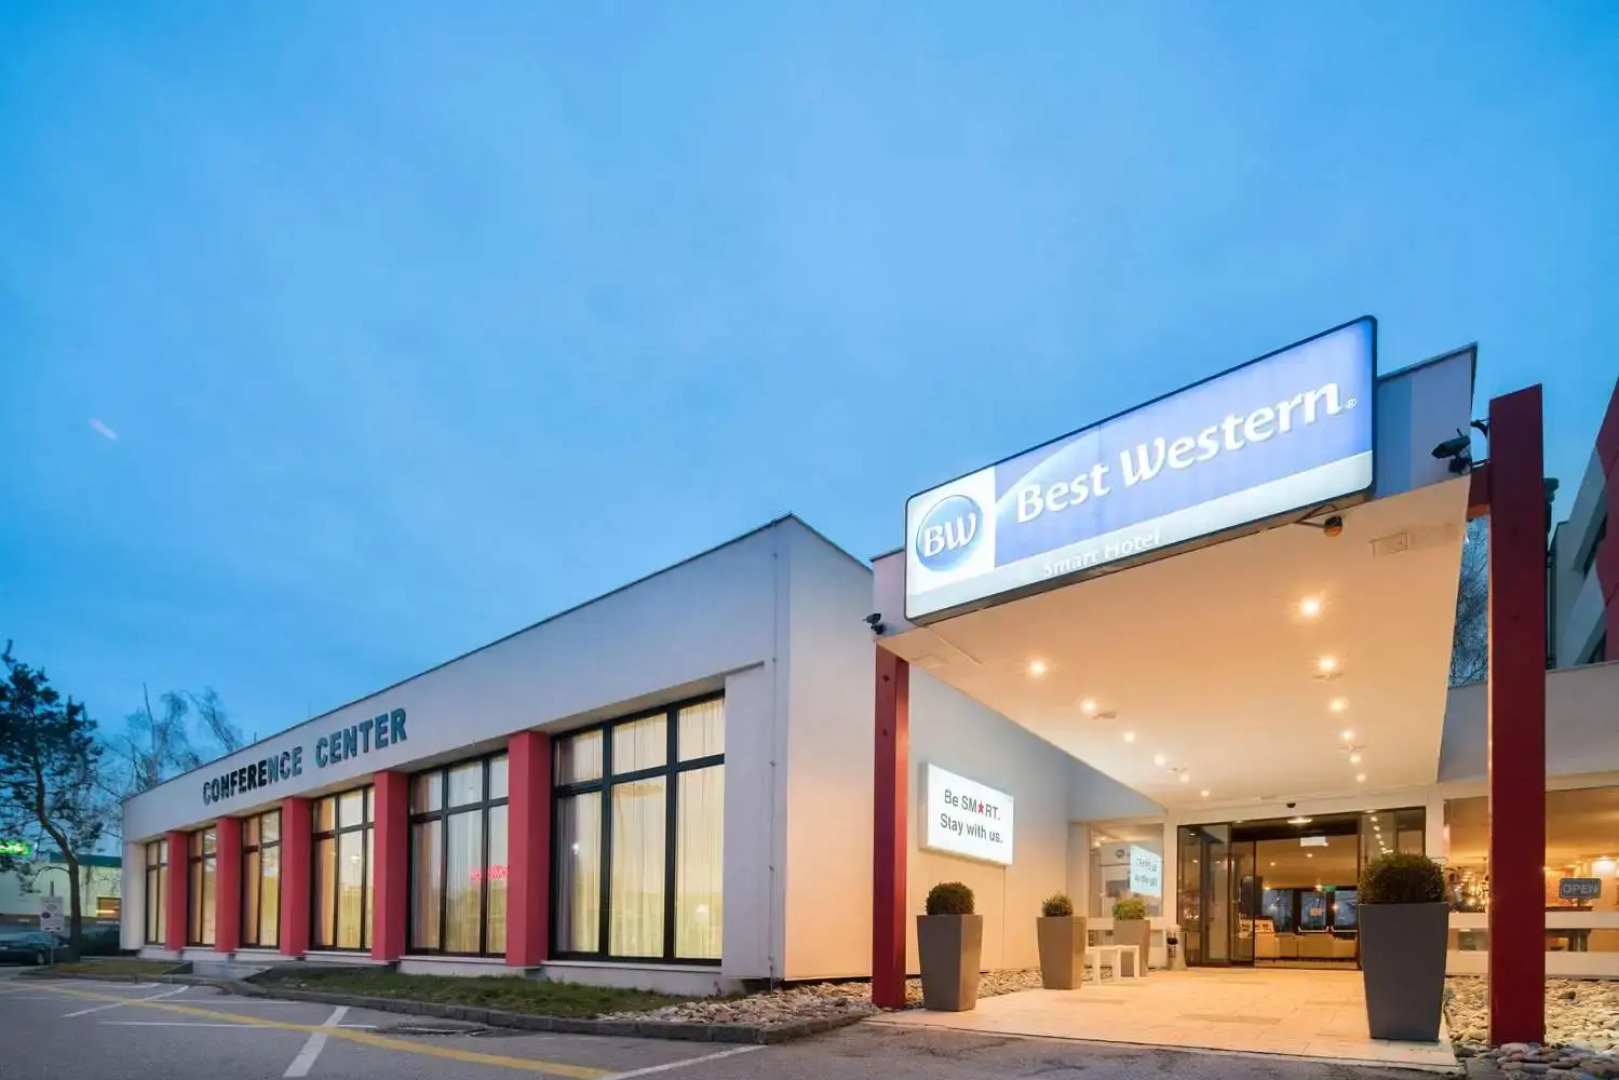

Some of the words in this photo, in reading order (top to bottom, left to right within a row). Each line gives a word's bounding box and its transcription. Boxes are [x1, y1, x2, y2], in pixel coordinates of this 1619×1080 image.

[1017, 464, 1110, 523] Best
[924, 511, 977, 557] BW
[1104, 527, 1161, 560] Hotel
[203, 746, 303, 806] CONFERENCE
[315, 707, 408, 769] CENTER
[944, 788, 959, 807] Be
[940, 813, 963, 836] Stay
[966, 823, 987, 839] with
[989, 830, 1003, 844] us.
[1563, 882, 1599, 894] OPEN
